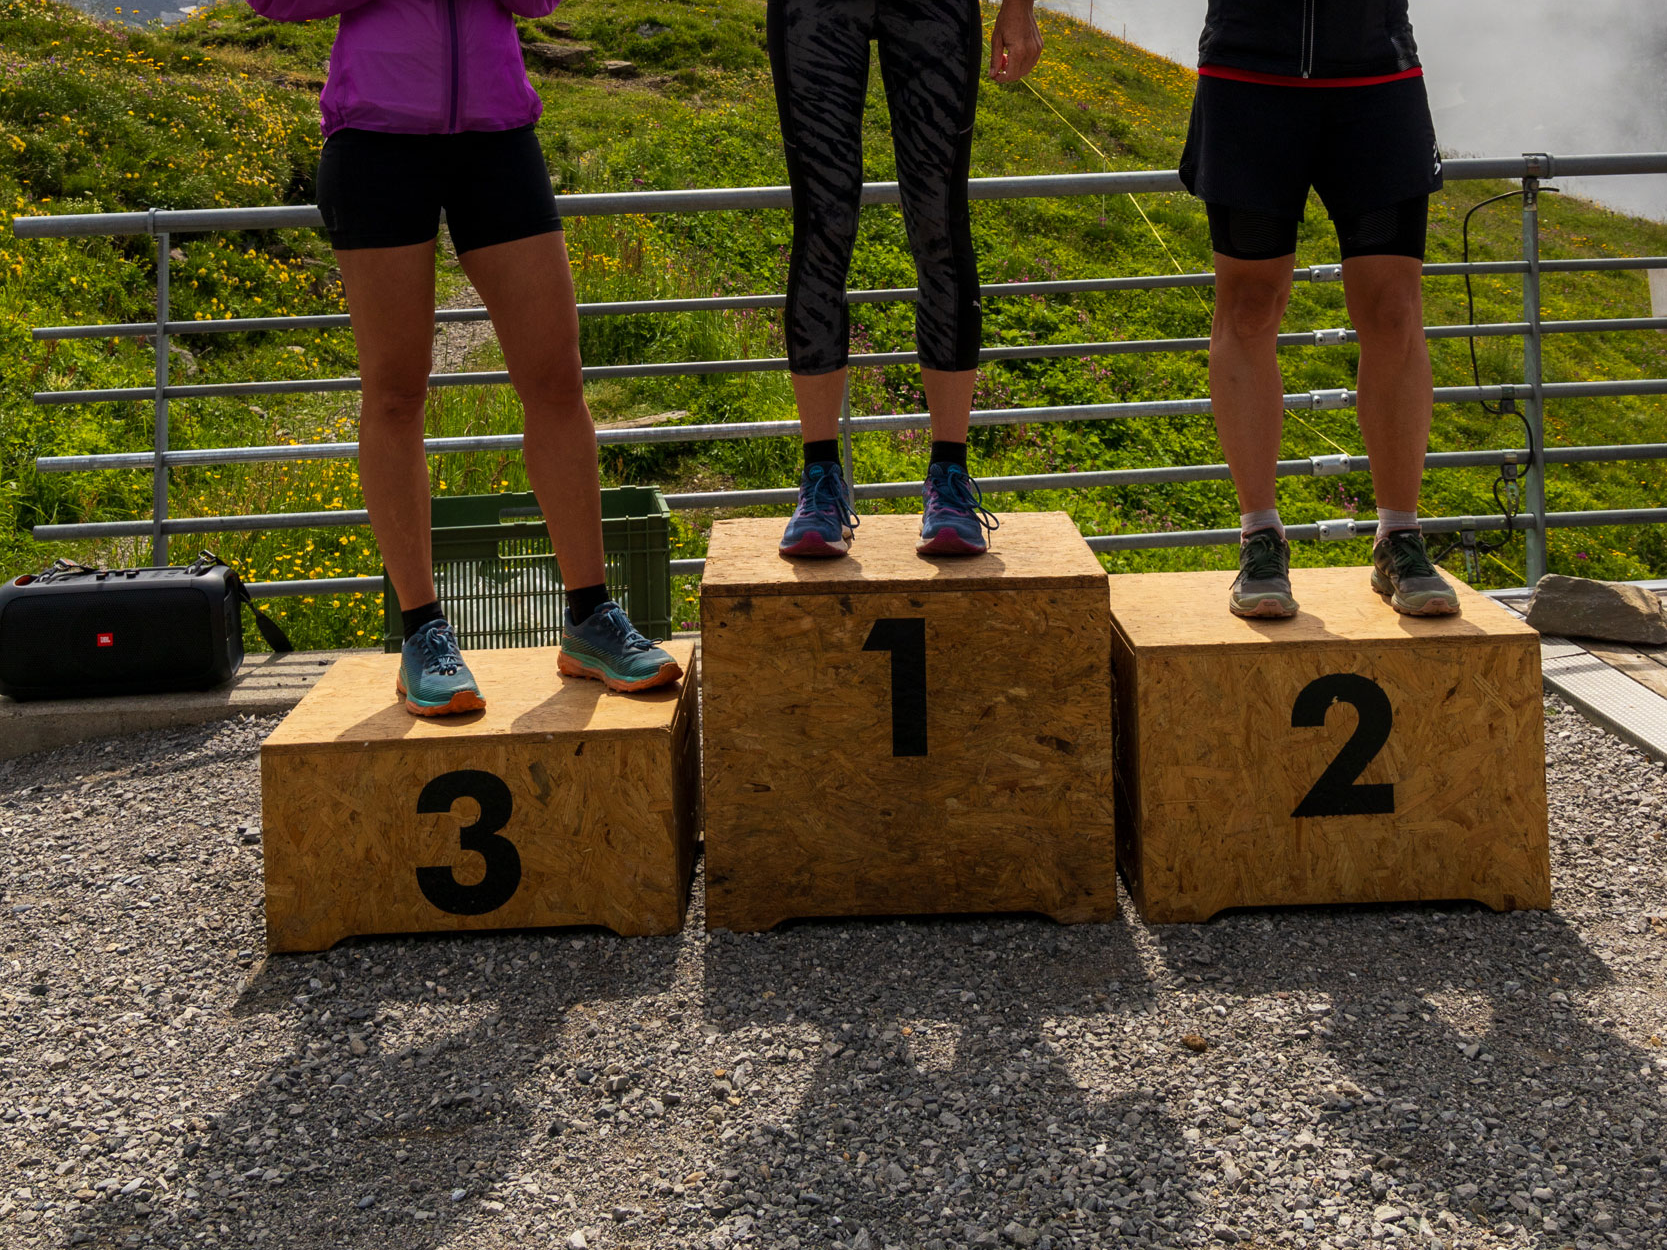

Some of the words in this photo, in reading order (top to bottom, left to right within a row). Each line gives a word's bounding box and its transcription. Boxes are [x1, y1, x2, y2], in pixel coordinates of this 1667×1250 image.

[861, 617, 928, 757] 1
[1290, 672, 1395, 818] 2
[416, 770, 522, 916] 3
